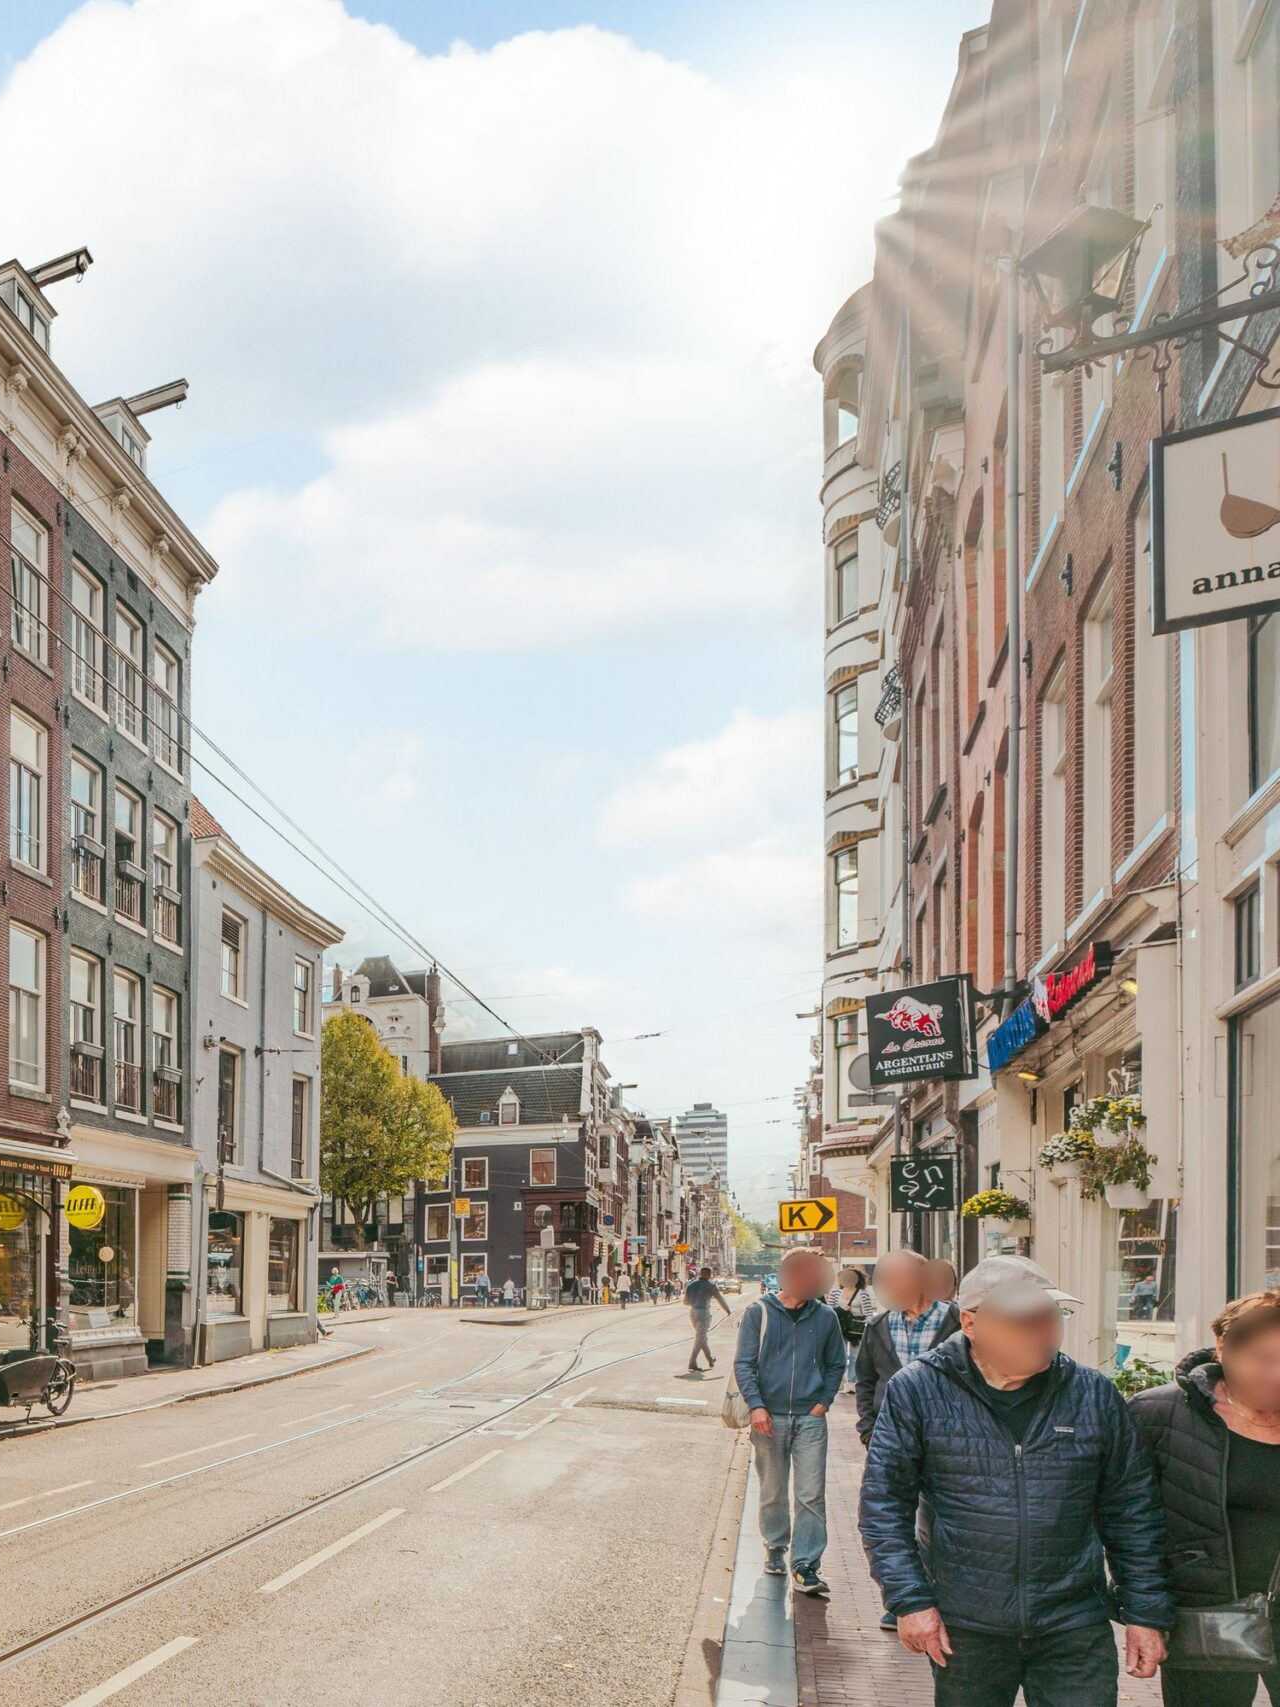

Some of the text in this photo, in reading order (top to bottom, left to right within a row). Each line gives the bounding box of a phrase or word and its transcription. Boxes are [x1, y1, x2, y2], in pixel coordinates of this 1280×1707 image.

[881, 1040, 901, 1055] La
[875, 1050, 954, 1071] ARGENTIJNS
[884, 1060, 946, 1077] restaurant
[788, 1206, 806, 1228] K
